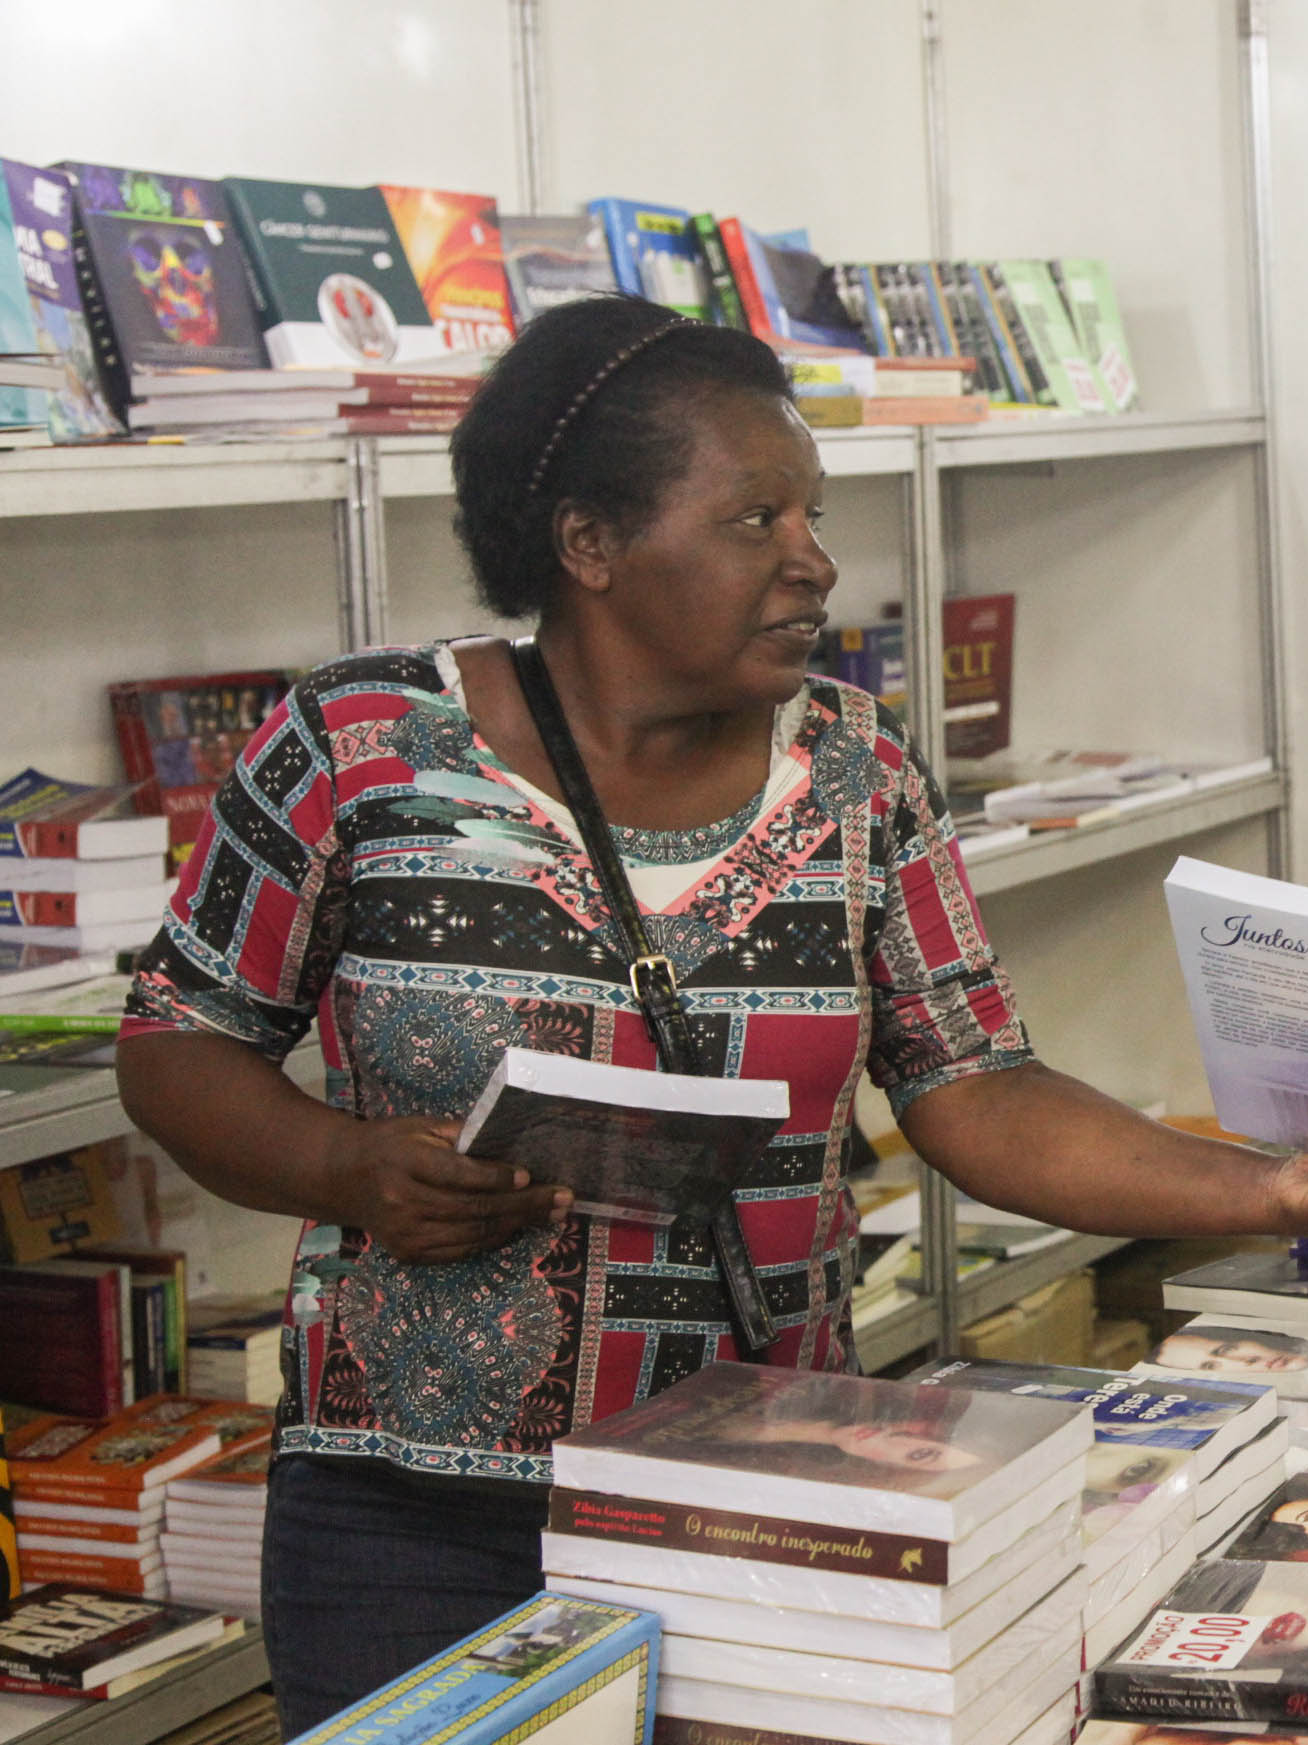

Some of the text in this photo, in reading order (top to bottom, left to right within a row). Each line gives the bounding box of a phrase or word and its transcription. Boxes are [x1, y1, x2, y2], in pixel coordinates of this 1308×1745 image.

[943, 641, 998, 680] CLT
[1084, 1377, 1147, 1408] Tere
[1110, 1392, 1151, 1414] está
[1138, 1394, 1188, 1420] Onde
[603, 1505, 666, 1524] Gasparetto
[685, 1513, 873, 1561] O encontro inesperado
[1130, 1615, 1185, 1661] PROMOÇÃO
[1168, 1617, 1250, 1663] 20,00
[374, 1664, 488, 1727] SAGRADA
